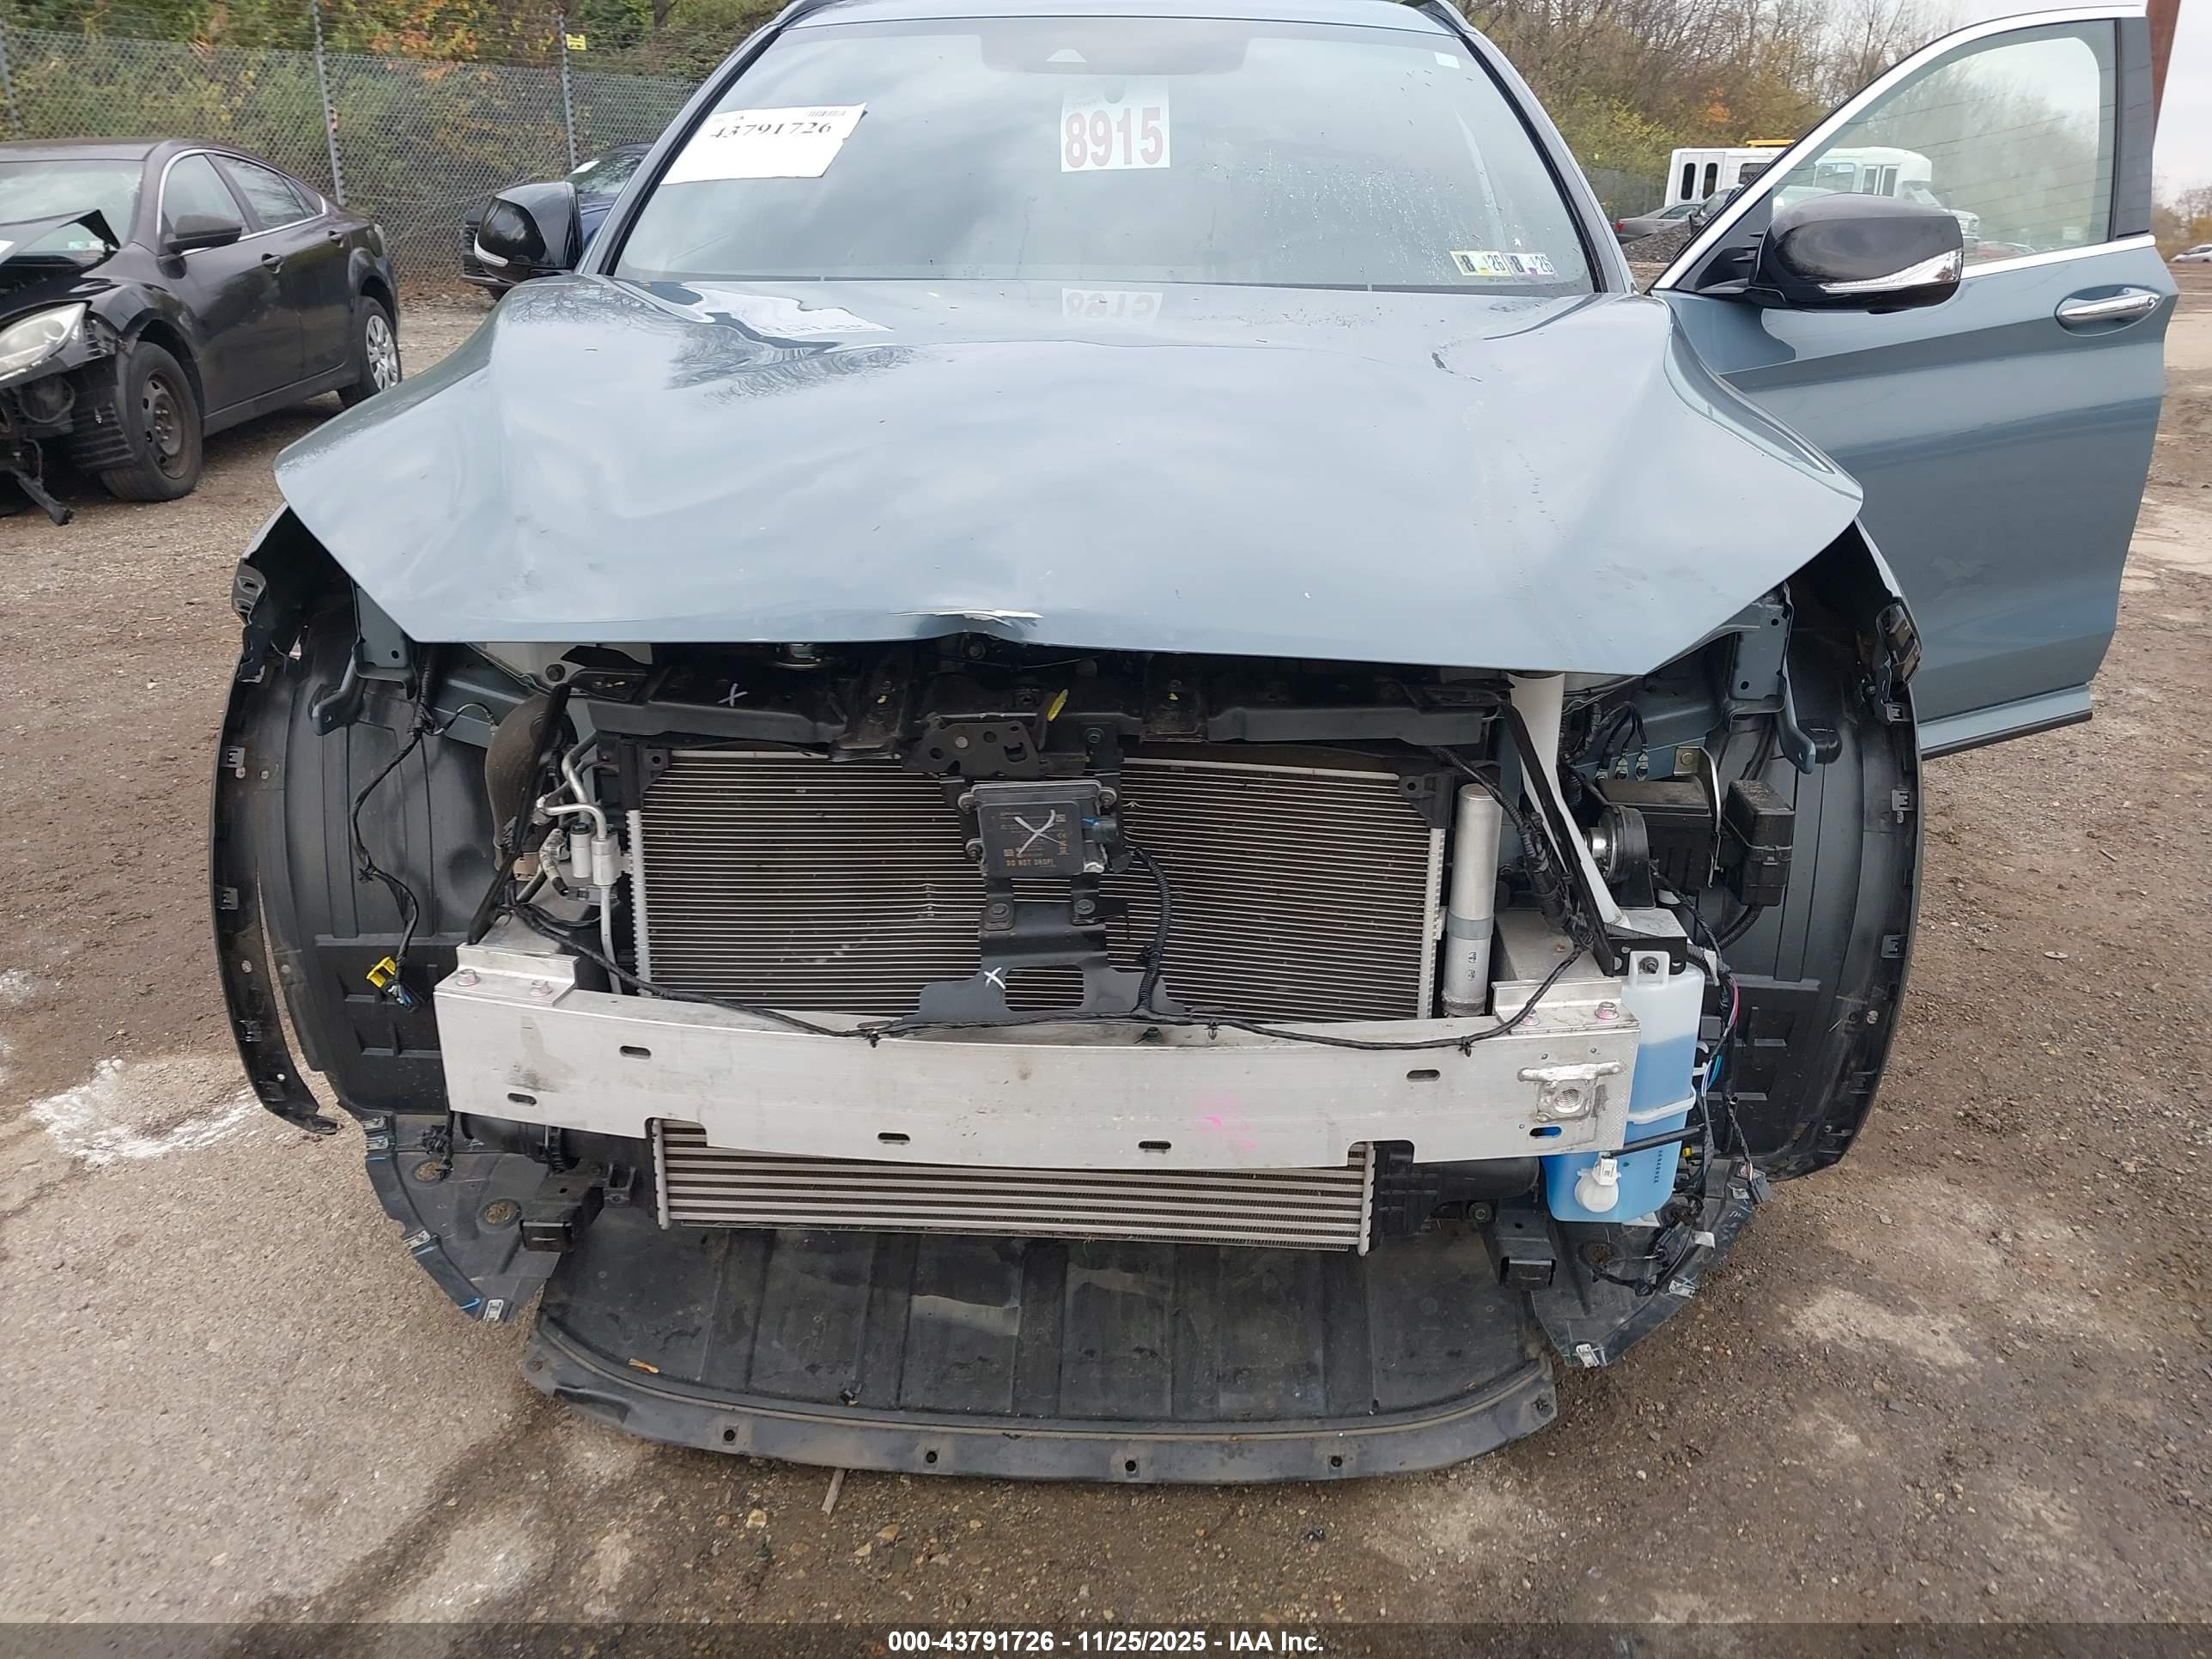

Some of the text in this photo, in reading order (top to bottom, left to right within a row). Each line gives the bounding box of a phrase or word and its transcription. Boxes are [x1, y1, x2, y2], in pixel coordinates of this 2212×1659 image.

[710, 122, 832, 138] 43791726
[1065, 106, 1164, 168] 8915
[1462, 255, 1476, 272] 8
[1510, 256, 1525, 273] 8
